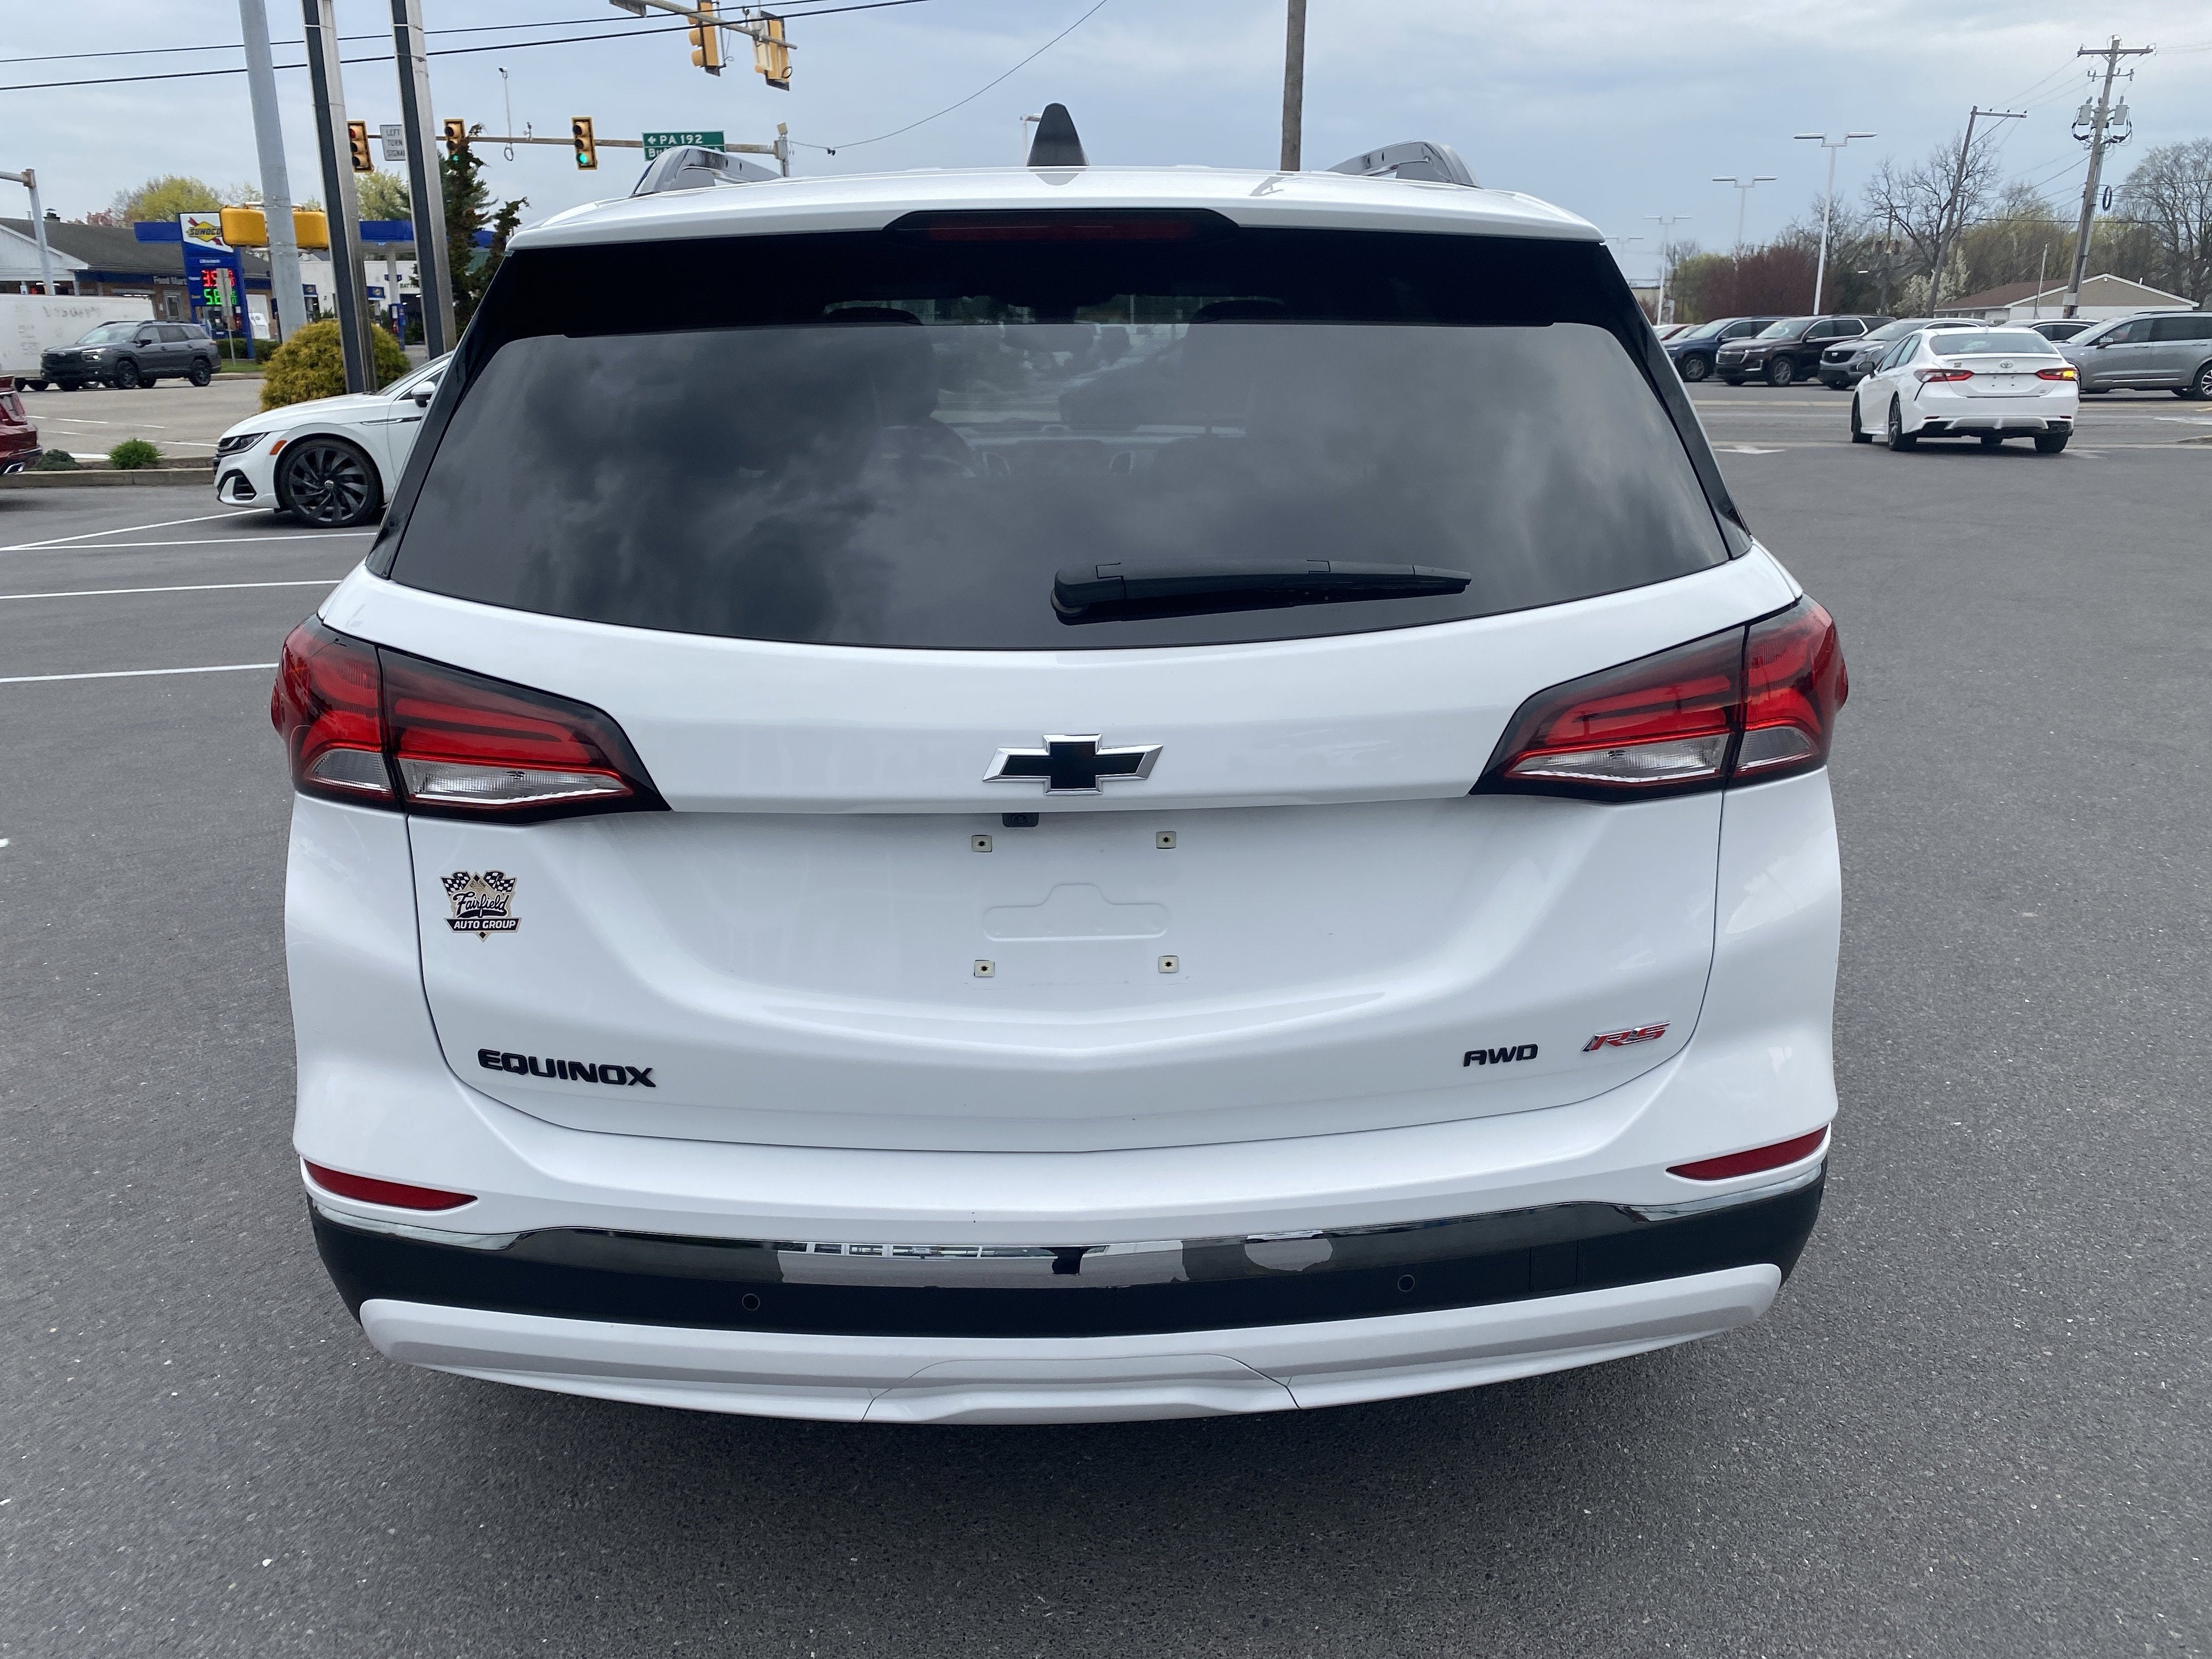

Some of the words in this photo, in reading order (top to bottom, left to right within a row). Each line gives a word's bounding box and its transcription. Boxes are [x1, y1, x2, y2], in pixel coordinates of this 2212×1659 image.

[660, 135, 678, 144] PA
[680, 134, 703, 144] 192
[453, 891, 509, 916] Fairfield
[454, 921, 480, 929] AUTO
[482, 920, 516, 929] GROUP
[1581, 1020, 1671, 1053] RS
[1463, 1043, 1538, 1067] AWD
[477, 1048, 657, 1088] EQUINOX
